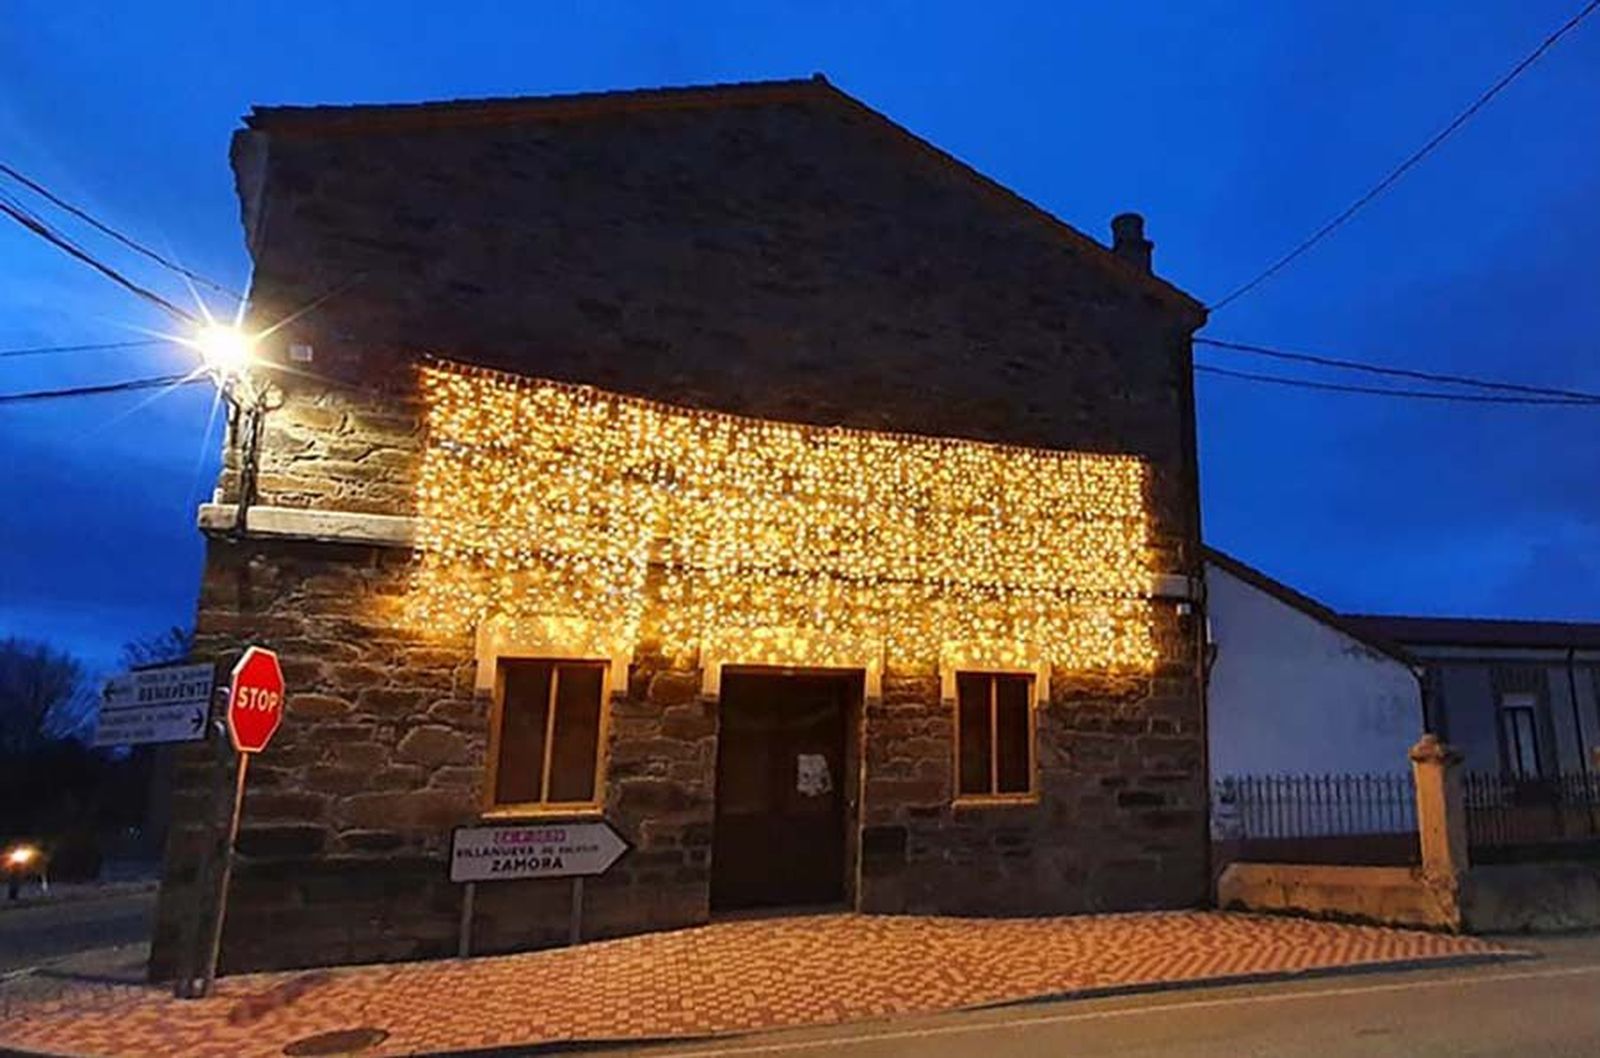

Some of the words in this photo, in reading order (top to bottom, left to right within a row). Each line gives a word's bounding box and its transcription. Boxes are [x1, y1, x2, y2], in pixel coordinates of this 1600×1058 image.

[138, 681, 208, 701] BENAVENTE
[236, 686, 279, 712] STOP
[456, 846, 534, 858] VILLANUEVA
[491, 857, 563, 872] ZAMORA
